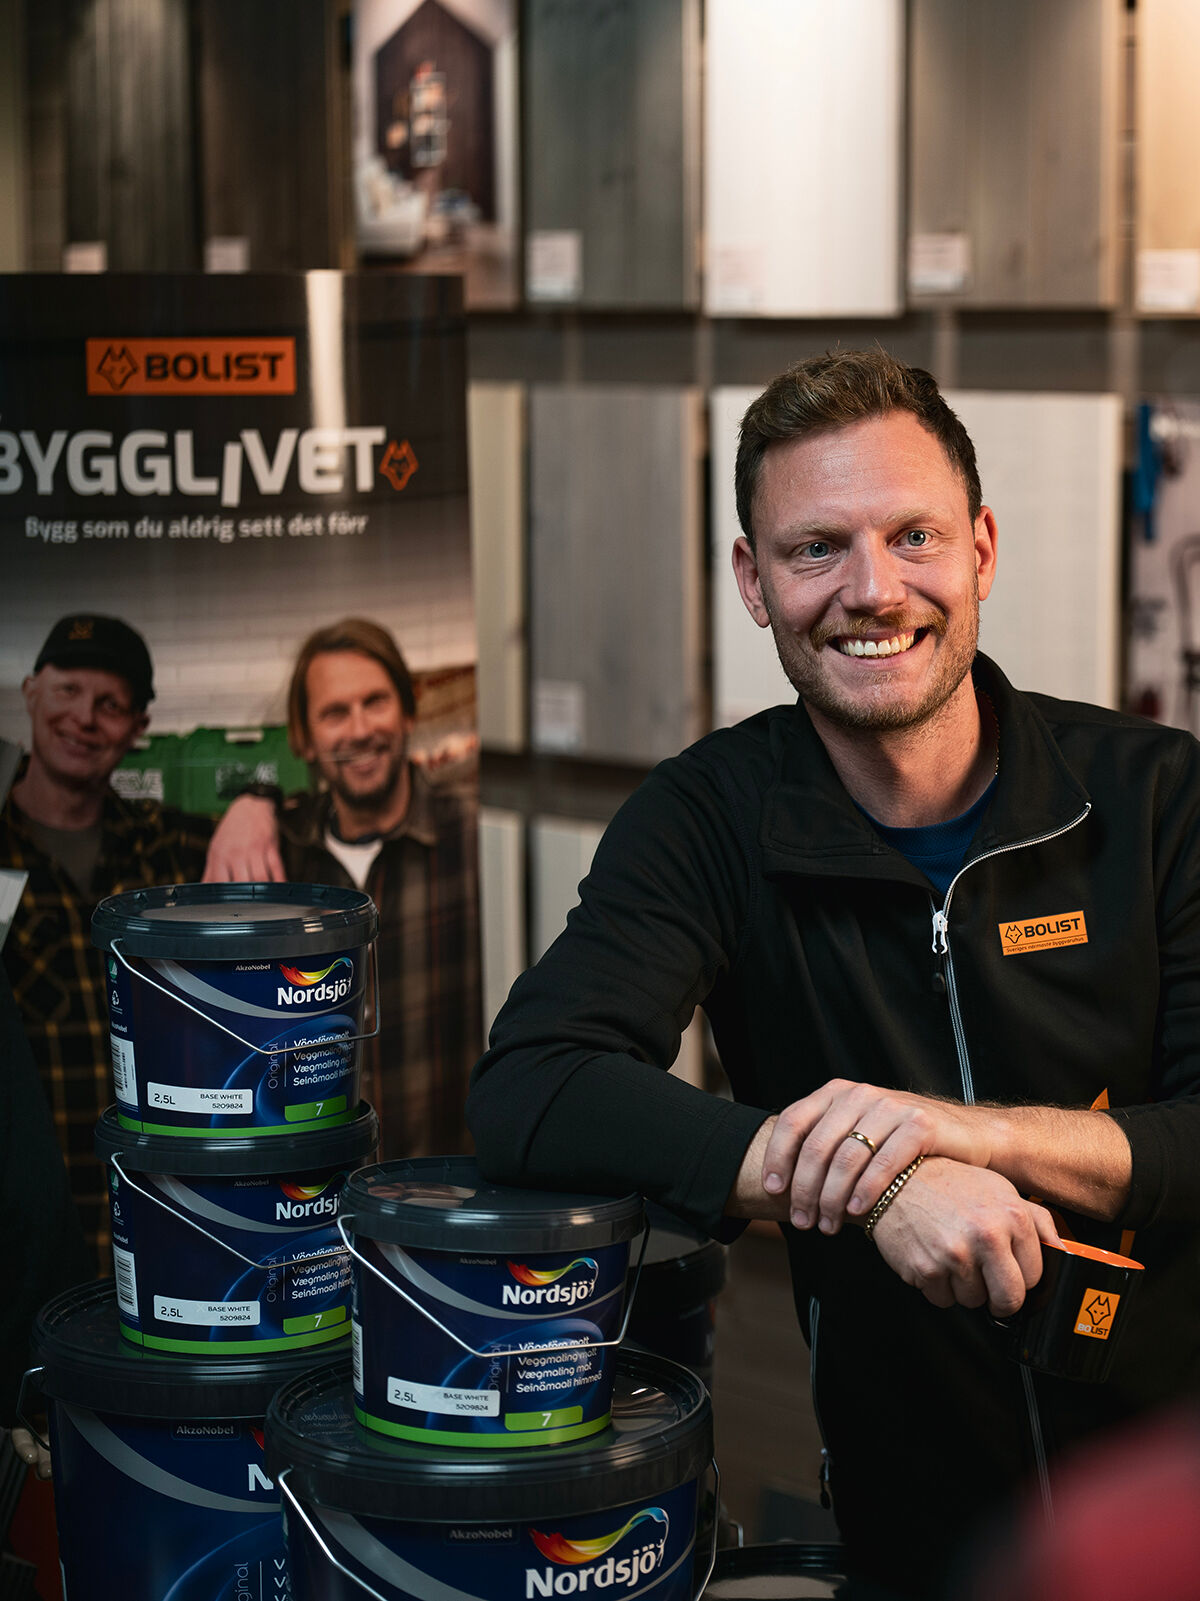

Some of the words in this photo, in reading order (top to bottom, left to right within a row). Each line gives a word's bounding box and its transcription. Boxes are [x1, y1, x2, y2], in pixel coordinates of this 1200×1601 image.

[145, 352, 285, 381] BOLIST
[0, 426, 387, 507] BYGGLIVET
[25, 516, 78, 543] Bygg
[82, 521, 130, 539] som
[134, 516, 162, 538] du
[168, 514, 235, 543] aldrig
[239, 515, 283, 537] sett
[287, 514, 325, 536] det
[328, 513, 369, 535] förr
[1024, 918, 1081, 938] BOLIST
[235, 964, 271, 972] AkzoNobel
[277, 979, 348, 1006] Nordsjö
[293, 1059, 340, 1074] Vægmaling
[293, 1070, 338, 1086] Seinämaali
[153, 1092, 176, 1106] 2,5L
[200, 1093, 220, 1101] BASE
[221, 1093, 243, 1101] WHITE
[315, 1102, 324, 1116] 7
[275, 1193, 341, 1220] Nordsj
[291, 1271, 339, 1286] Vægmaling
[291, 1284, 337, 1300] Seinämaali
[502, 1280, 589, 1306] Nordsjö
[160, 1306, 183, 1319] 2,5L
[207, 1305, 228, 1313] BASE
[228, 1305, 251, 1313] WHITE
[219, 1314, 251, 1322] 5209824
[314, 1314, 323, 1328] 7
[1077, 1323, 1108, 1336] BOLIST
[517, 1353, 578, 1368] Veggmaling
[517, 1367, 575, 1381] Vægmaling
[516, 1378, 572, 1393] Seinämaali
[443, 1392, 463, 1401] BASE
[464, 1394, 489, 1402] WHITE
[541, 1412, 552, 1427] 7
[176, 1425, 234, 1436] AkzoNobel
[449, 1528, 513, 1540] AkzoNobel
[525, 1543, 656, 1599] Nordsjö
[234, 1561, 253, 1601] ginal
